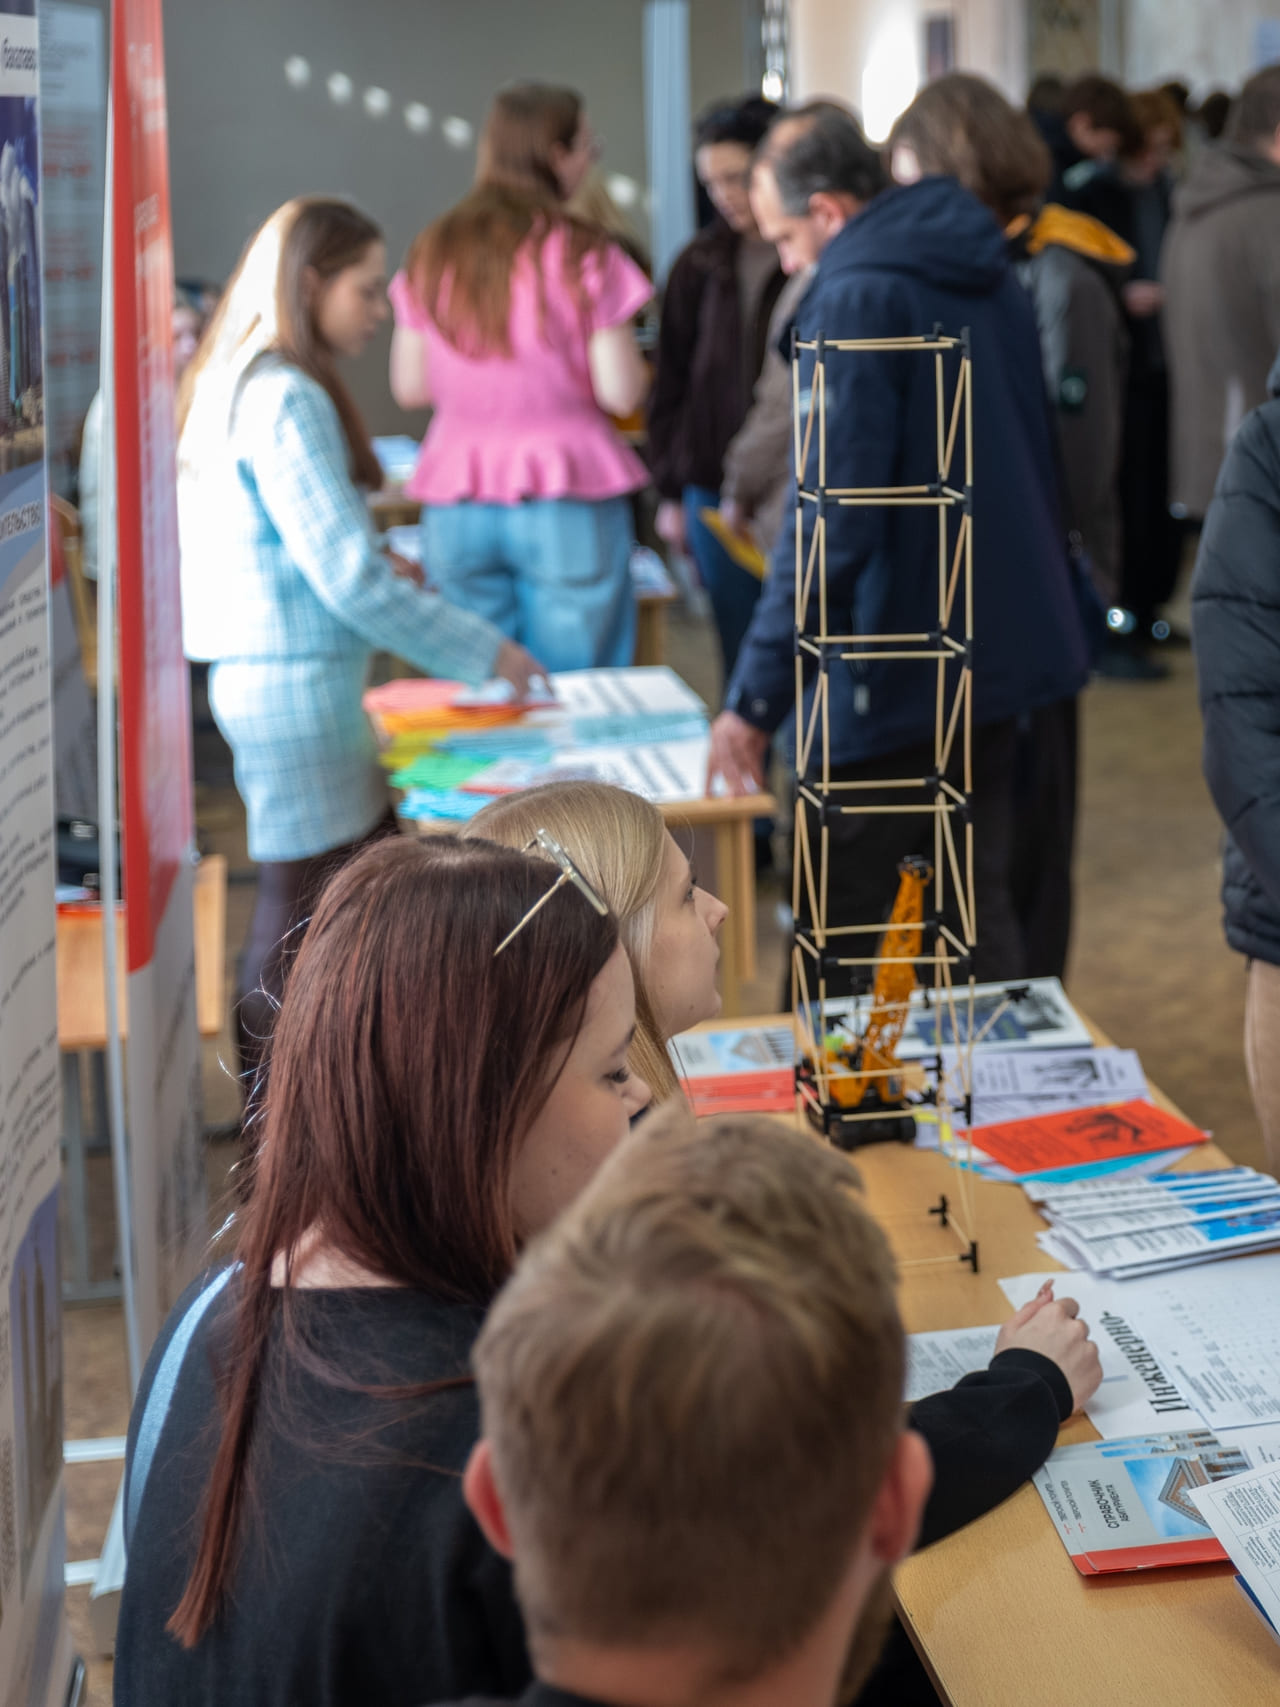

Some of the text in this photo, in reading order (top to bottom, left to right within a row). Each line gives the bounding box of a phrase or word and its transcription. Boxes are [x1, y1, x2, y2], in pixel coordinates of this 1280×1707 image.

[1099, 1310, 1191, 1415] Инженерно-
[1087, 1479, 1120, 1529] СПРАВОЧНИК
[1105, 1484, 1131, 1522] АБИТУРИЕНТА
